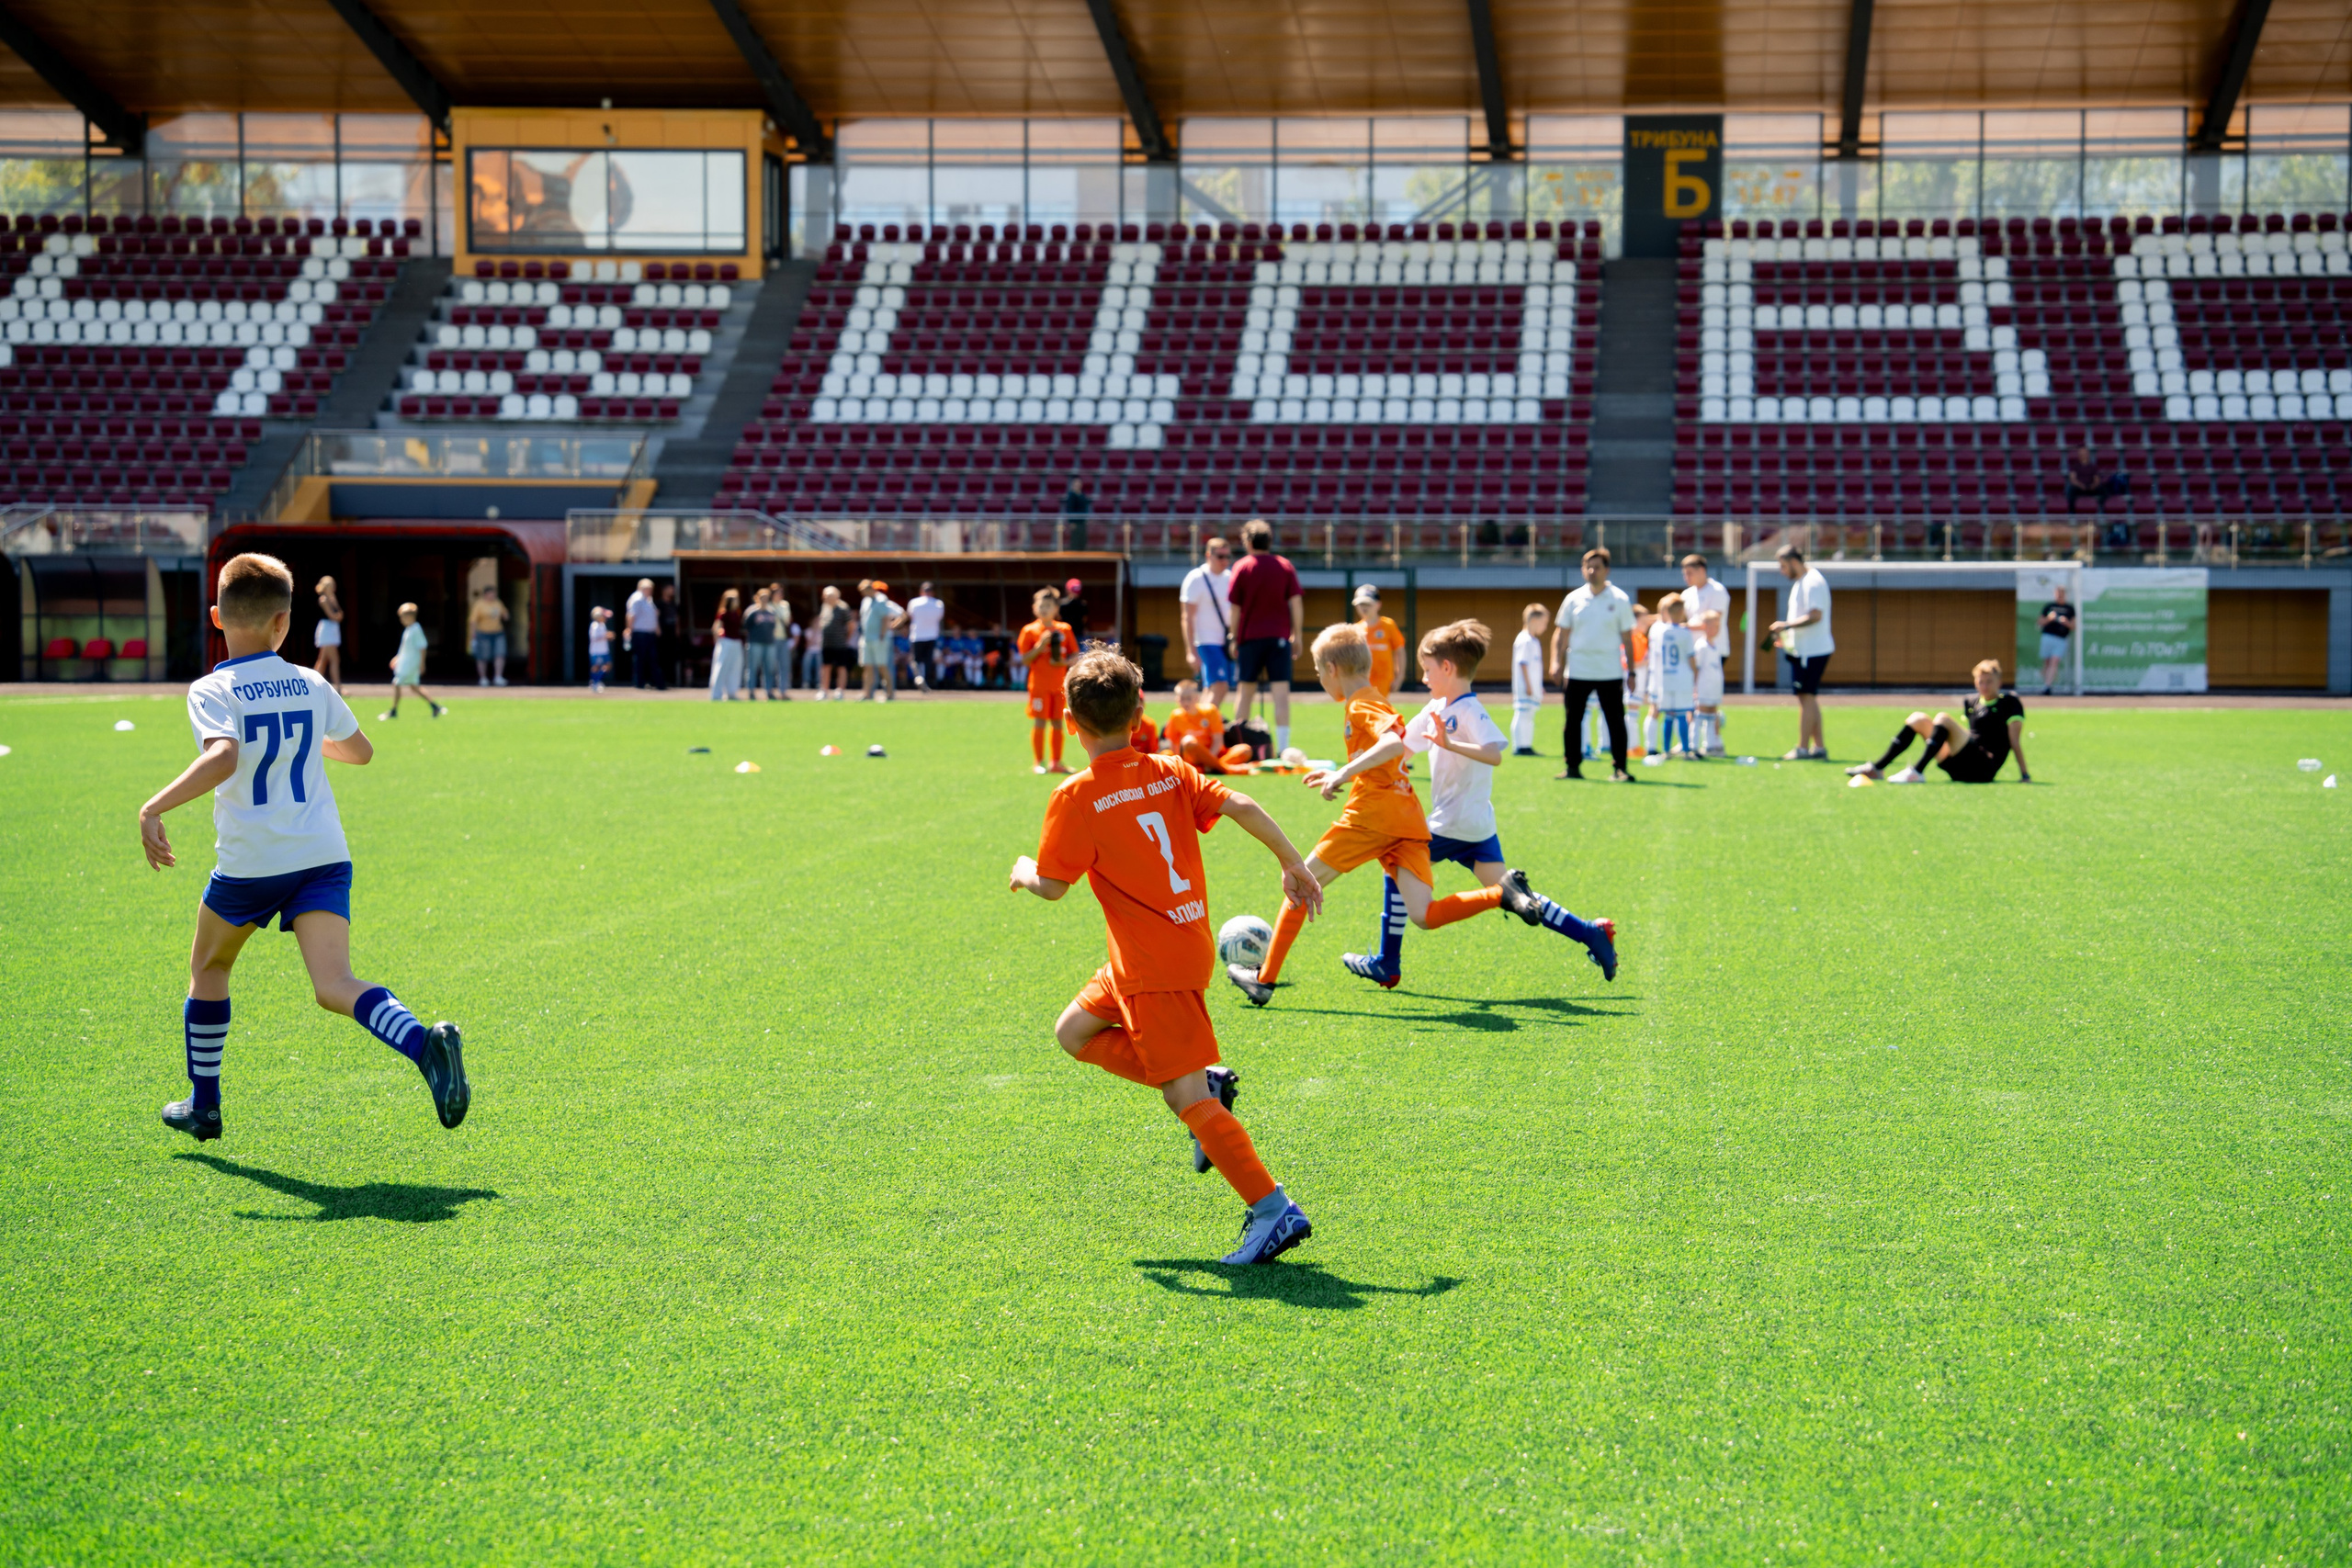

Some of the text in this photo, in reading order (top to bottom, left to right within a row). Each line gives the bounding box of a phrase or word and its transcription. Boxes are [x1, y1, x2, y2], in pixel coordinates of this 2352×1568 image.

[1630, 130, 1718, 148] ТРИБУНА
[1664, 148, 1711, 219] Б
[232, 678, 310, 703] ГОРБУНОВ
[243, 709, 313, 806] 77
[1092, 786, 1146, 814] МОСКОВСКАЯ
[1136, 811, 1192, 895] 2
